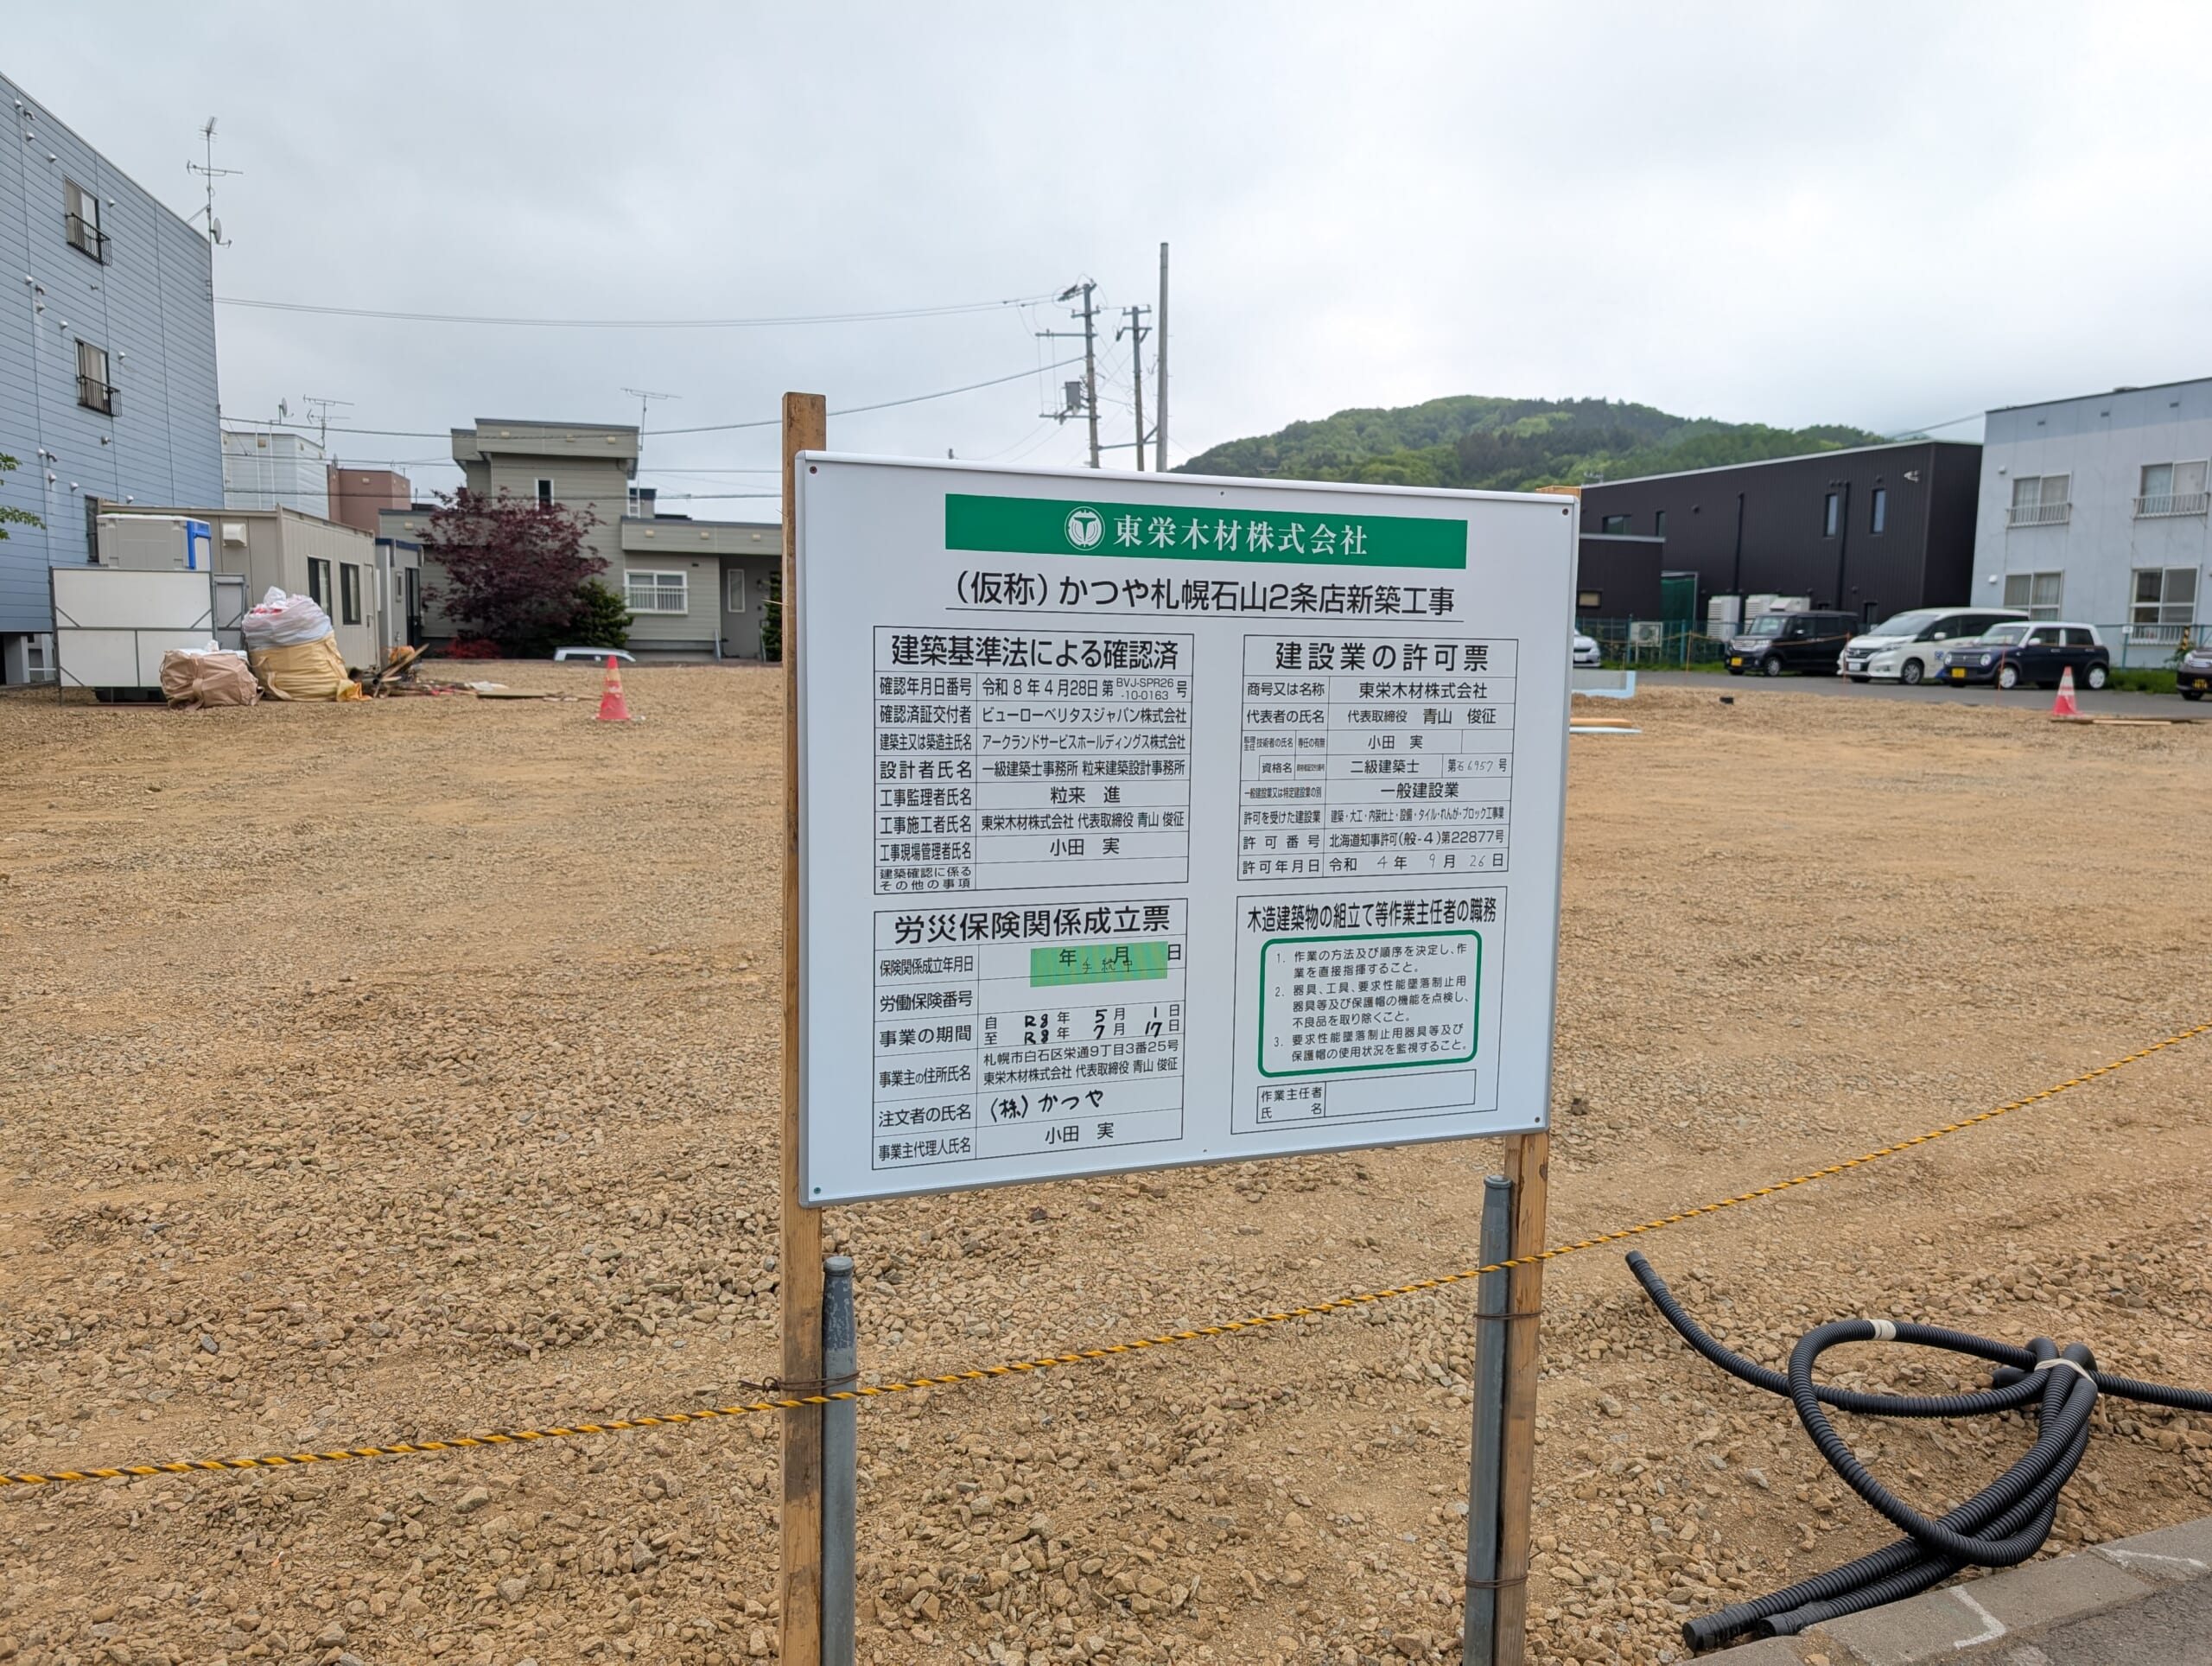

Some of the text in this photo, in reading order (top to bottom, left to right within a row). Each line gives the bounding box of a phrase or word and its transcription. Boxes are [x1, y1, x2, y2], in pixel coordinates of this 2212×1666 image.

[1113, 514, 1368, 556] 東栄木材株式会社
[892, 634, 1179, 671] 建築基準法による確認済
[1275, 641, 1489, 671] 建設業の許可票
[880, 677, 972, 696] 確認年月日番号
[1247, 682, 1325, 697] 商号又は名称
[1359, 682, 1488, 699] 東栄木材株式会社
[880, 704, 972, 724] 確認済証交付者
[982, 707, 1187, 724] ビューローベリタスジャパン株式会社
[1247, 709, 1325, 724] 代表者の氏名
[1347, 708, 1497, 725] 代表取締役 青山 俊征
[880, 733, 972, 752] 建築主又は築造主氏名
[982, 733, 1186, 751] アークランドサービスホールディングス株式会社
[880, 760, 972, 779] 設計者氏名
[982, 760, 1185, 778] 一級建築士事務所 粒来建築設計事務所
[1262, 762, 1293, 773] 資格名
[1351, 760, 1421, 774] 二級建築士
[880, 787, 972, 807] 工事監理者氏名
[1380, 782, 1459, 798] 一般建設業
[880, 815, 972, 835] 工事施工者氏名
[981, 811, 1185, 832] 東栄木材株式会社 代表取締役 青山 俊征
[1244, 811, 1321, 824] 許可を受けた建設業
[1243, 834, 1320, 849] 許可番号
[880, 841, 971, 862] 工事現場管理者氏名
[880, 866, 971, 880] 建築確認に係る
[1243, 858, 1319, 874] 許可年月日
[880, 878, 970, 891] その他の事項
[1247, 897, 1497, 932] 木造建築物の組立て等作業主任者の職務
[894, 905, 1170, 944] 労災保険関係成立票
[1294, 943, 1467, 963] 作業の方法及び順序を決定し、作
[880, 956, 974, 977] 保険関係成立年月日
[1294, 962, 1418, 979] 業を直接指揮すること。
[880, 990, 973, 1013] 労働保険番号
[1293, 1010, 1410, 1029] 不良品を取り除くこと。
[879, 1026, 972, 1048] 事業の期間
[983, 1040, 1179, 1066] 札幌市白石区栄通9丁目3番25号
[1292, 1039, 1467, 1063] 保護帽の使用状況を監視すること。
[879, 1065, 970, 1088] 事業主の住所氏名
[983, 1056, 1178, 1086] 東栄木材株式会社 代表取締役 青山 俊征
[1262, 1086, 1323, 1103] 作業主任者
[879, 1103, 972, 1128] 注文者の氏名
[879, 1136, 970, 1162] 事業主代理人氏名
